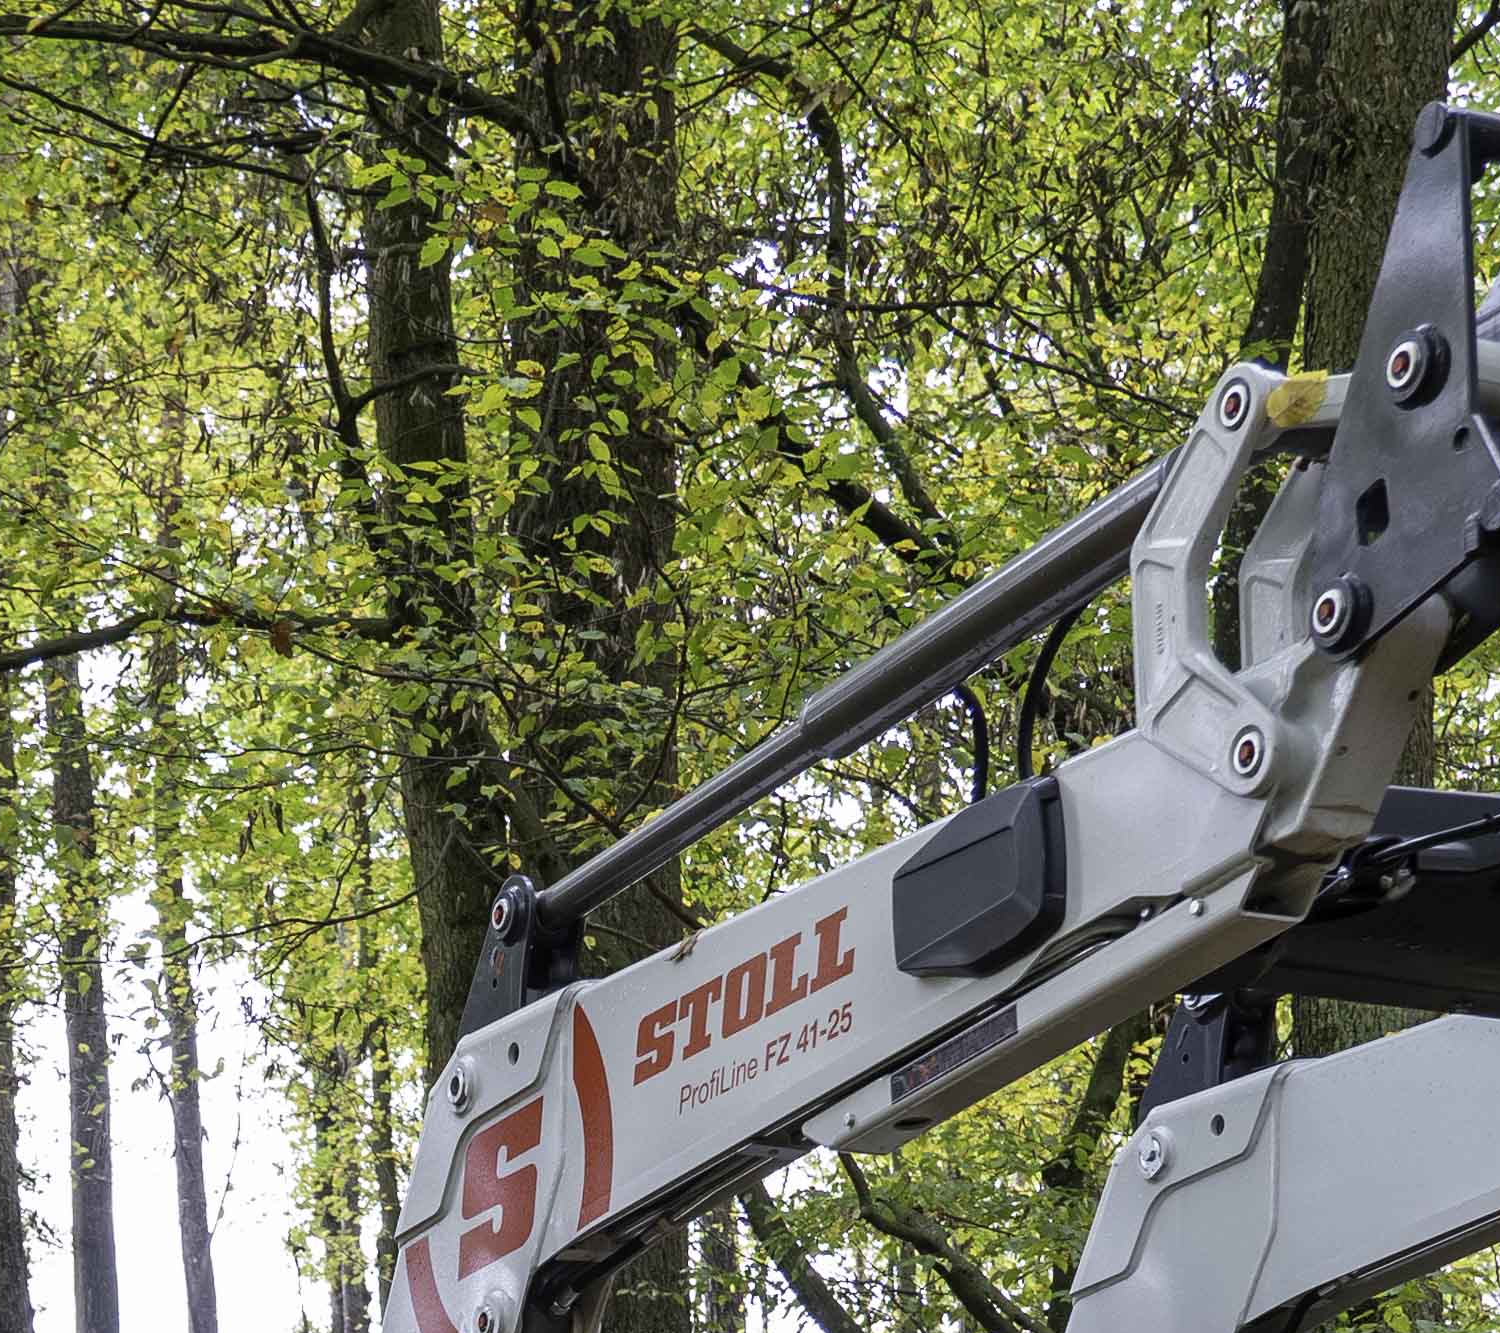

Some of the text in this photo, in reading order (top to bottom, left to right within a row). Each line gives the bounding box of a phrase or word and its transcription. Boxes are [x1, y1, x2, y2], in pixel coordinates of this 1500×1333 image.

[633, 905, 856, 1087] STOLL
[679, 1001, 853, 1115] ProfiLine FZ 41-25
[458, 1096, 544, 1281] S
